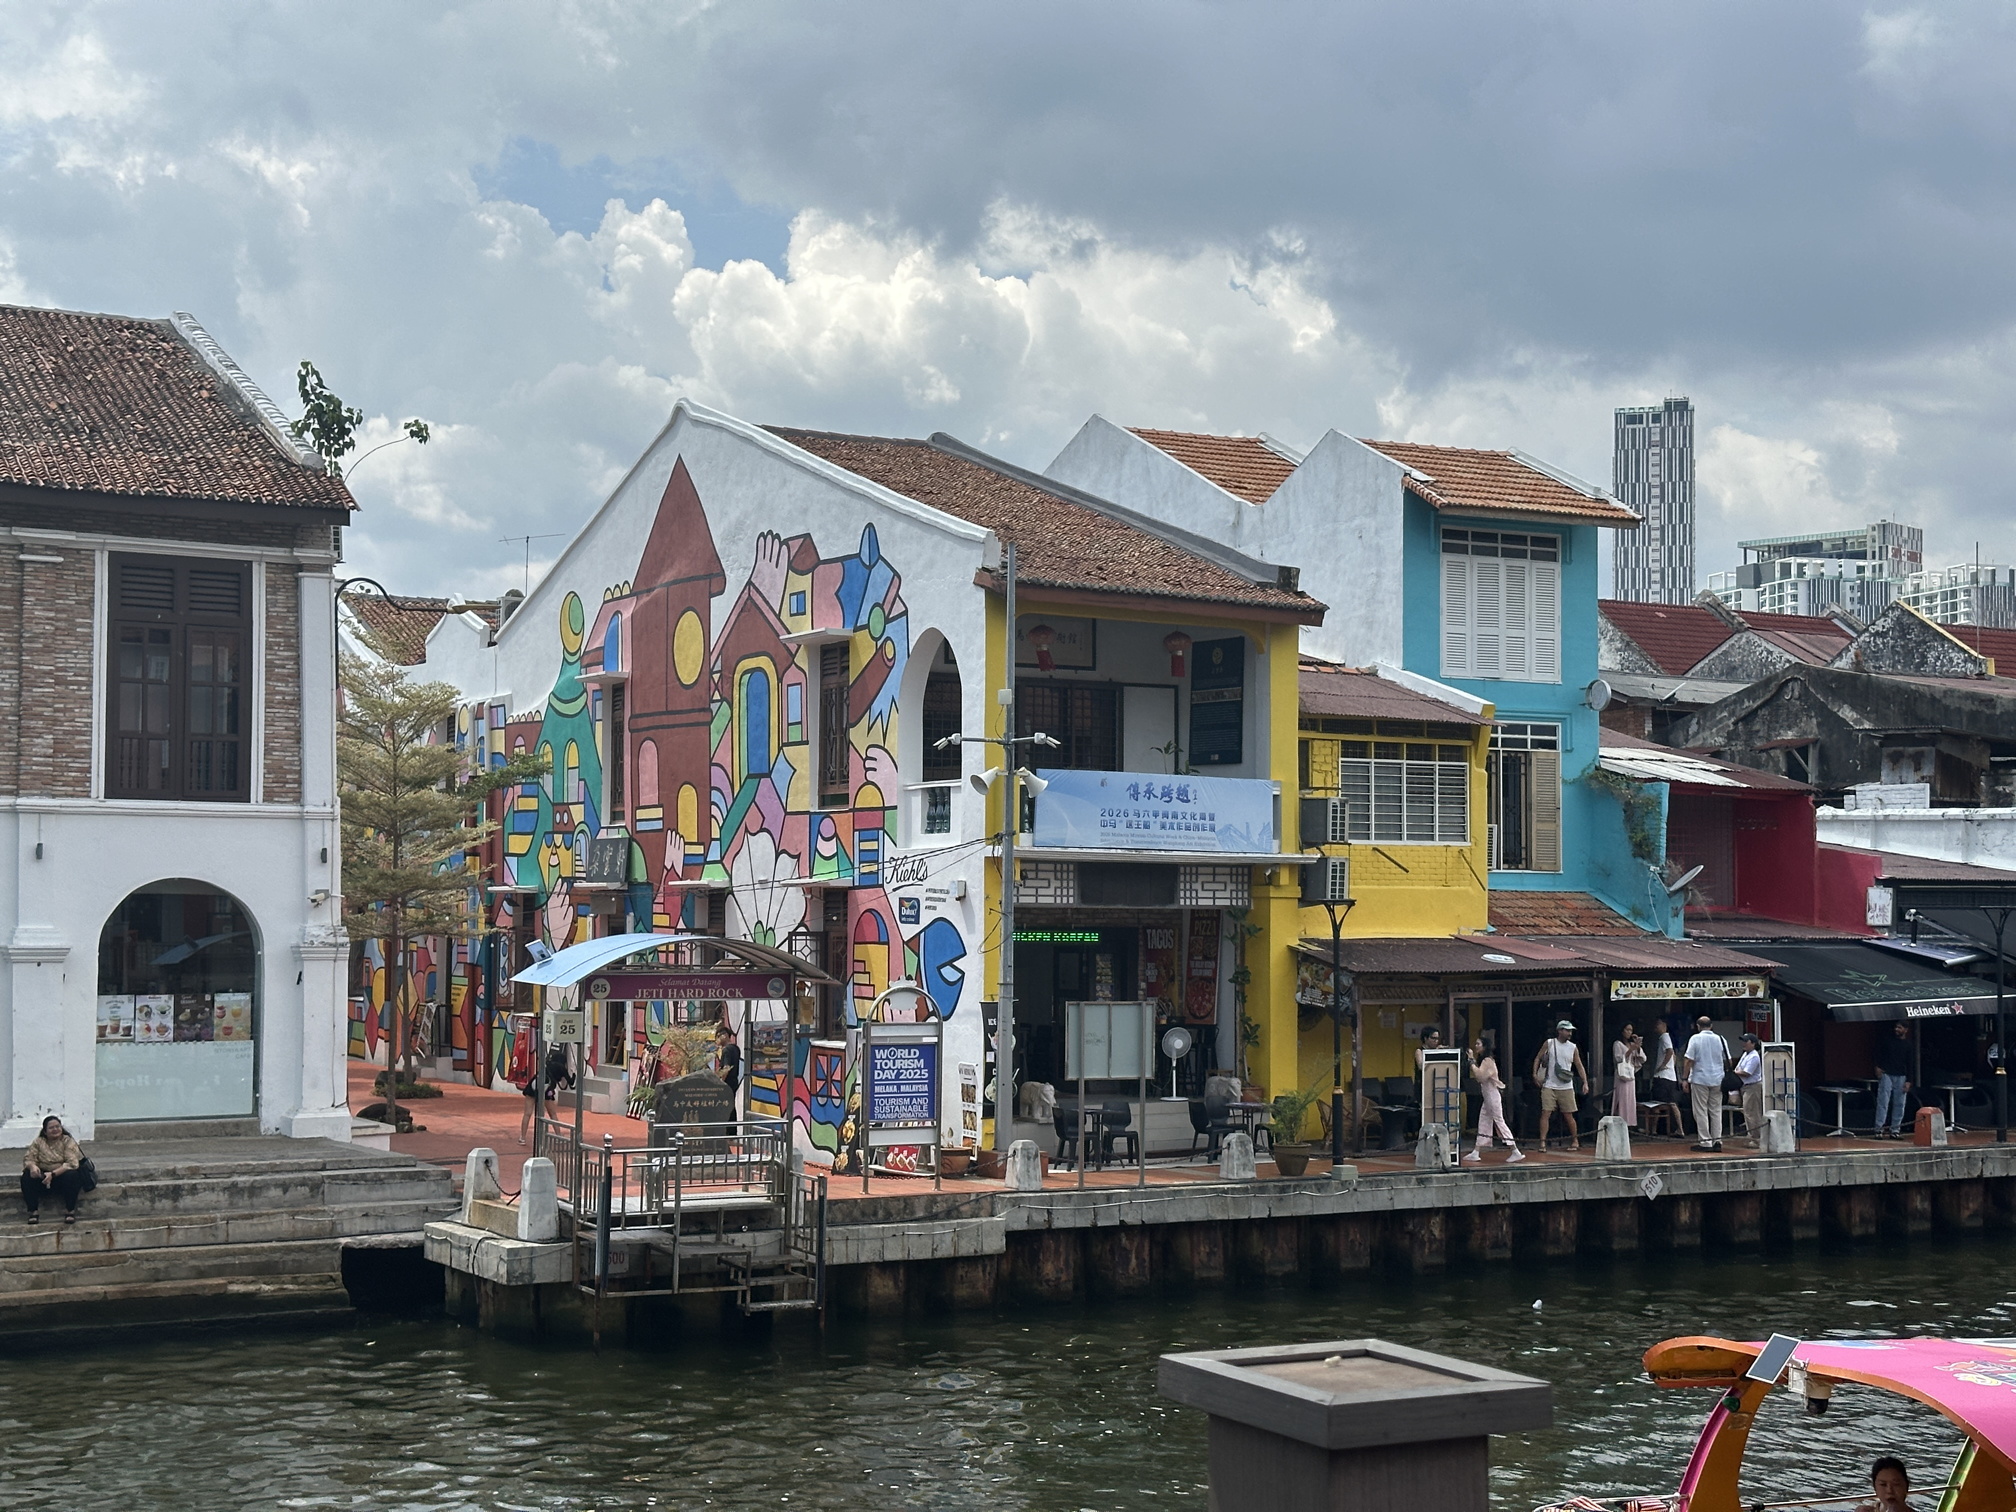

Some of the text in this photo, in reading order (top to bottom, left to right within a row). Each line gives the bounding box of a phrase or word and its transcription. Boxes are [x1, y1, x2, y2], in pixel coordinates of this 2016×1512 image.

[1100, 808, 1129, 818] 2026
[885, 855, 928, 884] Kiehl's
[1194, 920, 1217, 936] PIZZA
[1146, 928, 1174, 949] TACOS
[593, 983, 607, 993] 25
[658, 978, 722, 988] Selamat Datang
[1652, 981, 1671, 989] TRY
[1674, 981, 1707, 989] LOKAL
[635, 988, 743, 998] JETI HARD ROCK
[1905, 1005, 1951, 1017] Heineken
[545, 1023, 552, 1034] 25
[560, 1024, 576, 1035] 25
[875, 1047, 919, 1059] WORLD
[875, 1059, 924, 1070] TOURISM
[874, 1069, 928, 1080] DAY 2025
[901, 1084, 928, 1093] MALAYSIA
[875, 1097, 928, 1106] TOURISM AND
[874, 1104, 928, 1113] SUSTAINABLE
[1645, 1176, 1658, 1193] 510
